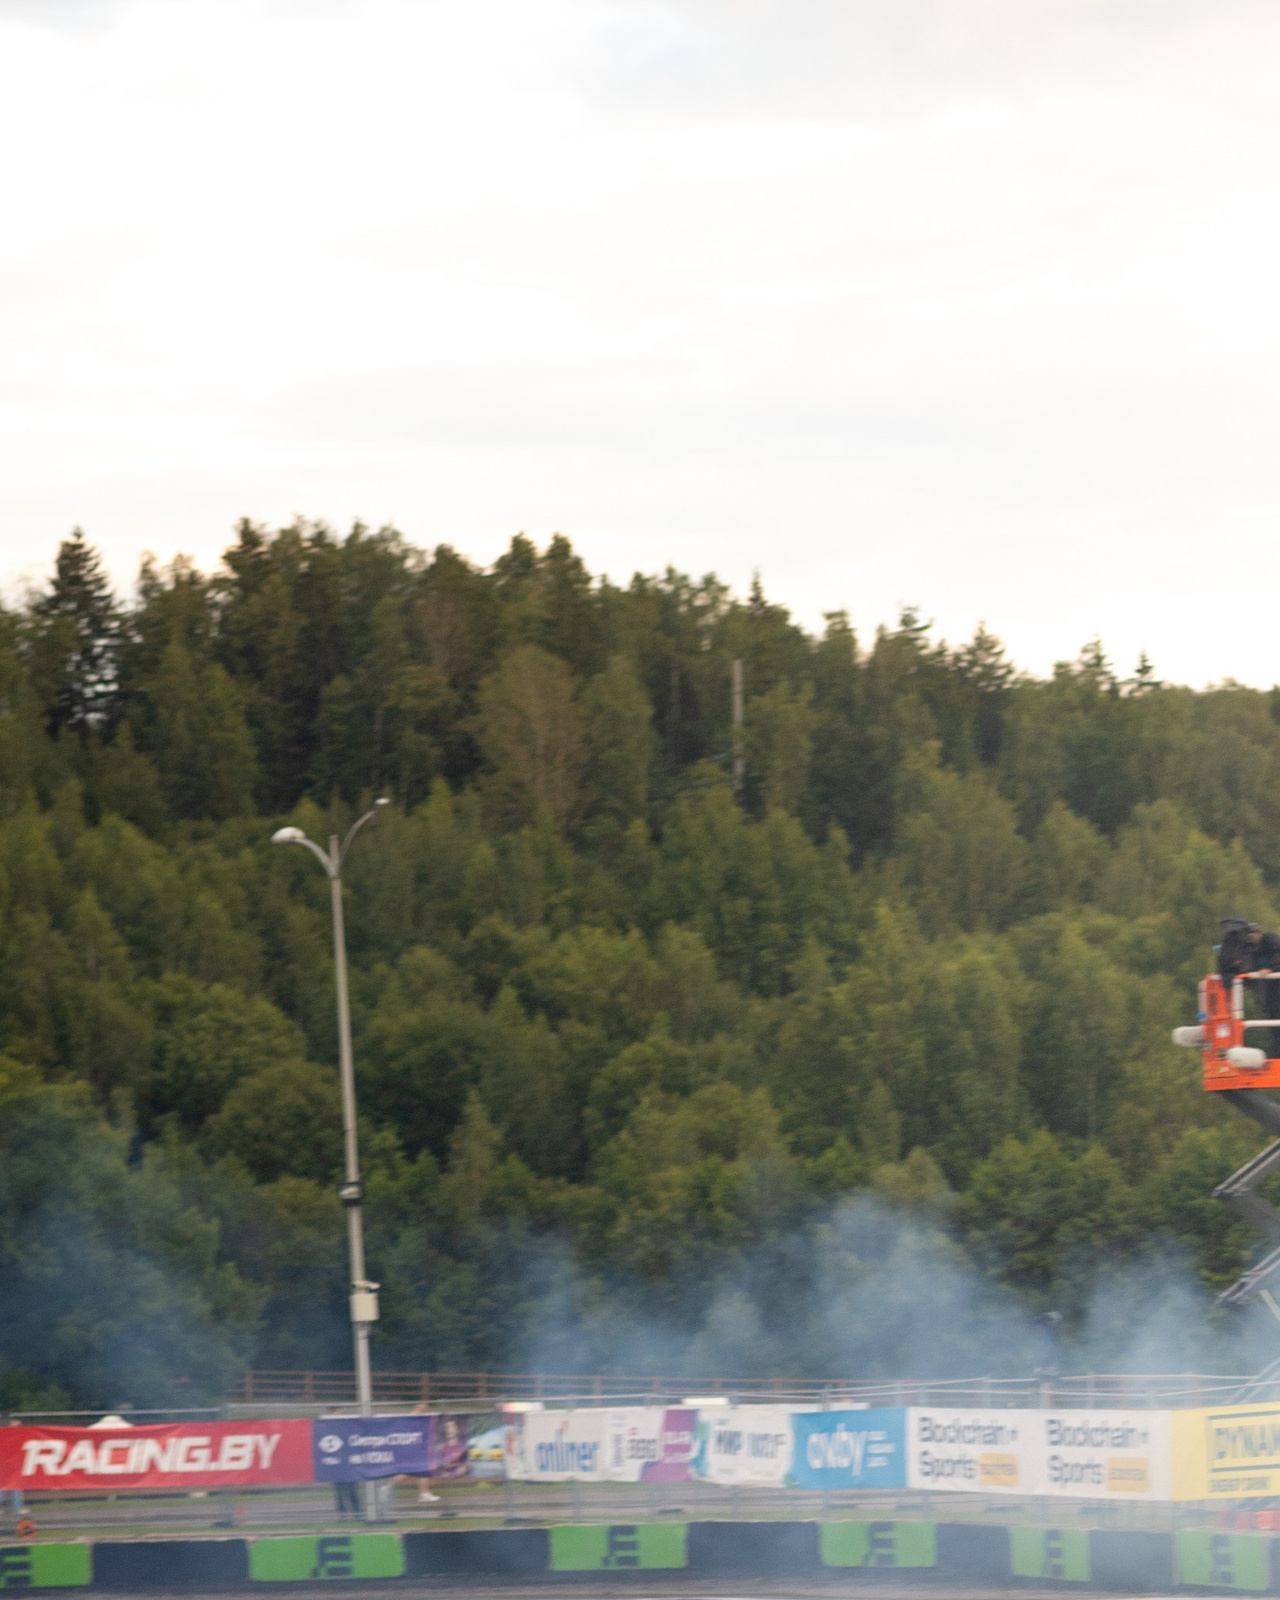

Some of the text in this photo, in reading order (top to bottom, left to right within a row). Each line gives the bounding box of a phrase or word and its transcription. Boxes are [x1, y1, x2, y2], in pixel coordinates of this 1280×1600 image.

[918, 1416, 1007, 1446] Blockchain
[1046, 1418, 1138, 1449] Blockchain
[21, 1433, 282, 1477] RACING.BY
[918, 1450, 977, 1482] Sports
[1048, 1454, 1105, 1488] Sports
